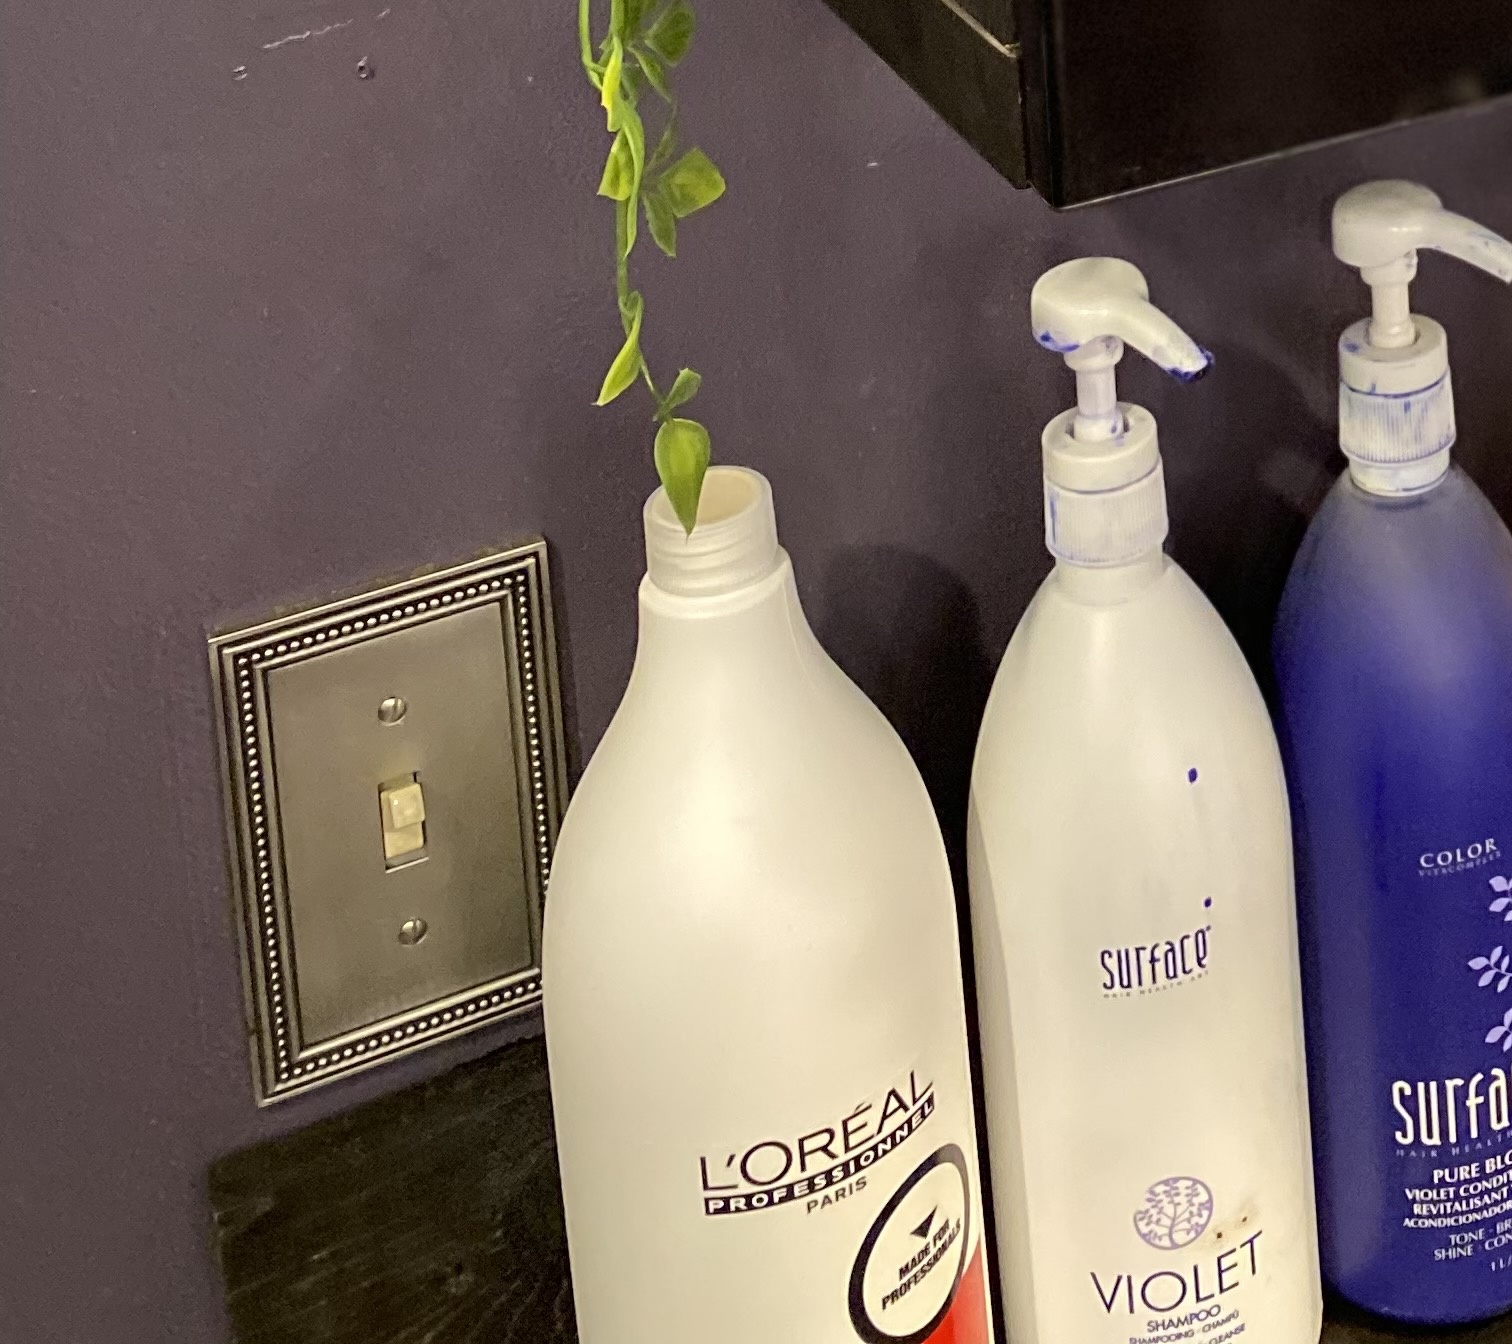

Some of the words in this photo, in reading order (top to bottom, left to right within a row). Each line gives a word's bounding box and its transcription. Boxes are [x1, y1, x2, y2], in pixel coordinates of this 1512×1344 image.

[1420, 838, 1497, 868] COLOR
[1100, 928, 1208, 990] surface
[700, 1069, 933, 1192] L'ORÉAL
[706, 1096, 934, 1214] PROFESSIONNEL
[1433, 1162, 1480, 1184] PURE
[806, 1175, 868, 1215] PARIS
[1405, 1186, 1456, 1202] VIOLET
[1413, 1185, 1509, 1216] REVITALISANT
[1403, 1199, 1512, 1229] ACONDICIONADOR
[1434, 1244, 1475, 1261] SHINE
[1449, 1228, 1485, 1247] TONE
[881, 1217, 960, 1311] PROFESSIONALS
[898, 1241, 931, 1282] MADE
[1089, 1229, 1263, 1314] VIOLET
[1146, 1304, 1221, 1333] SHAMPOO
